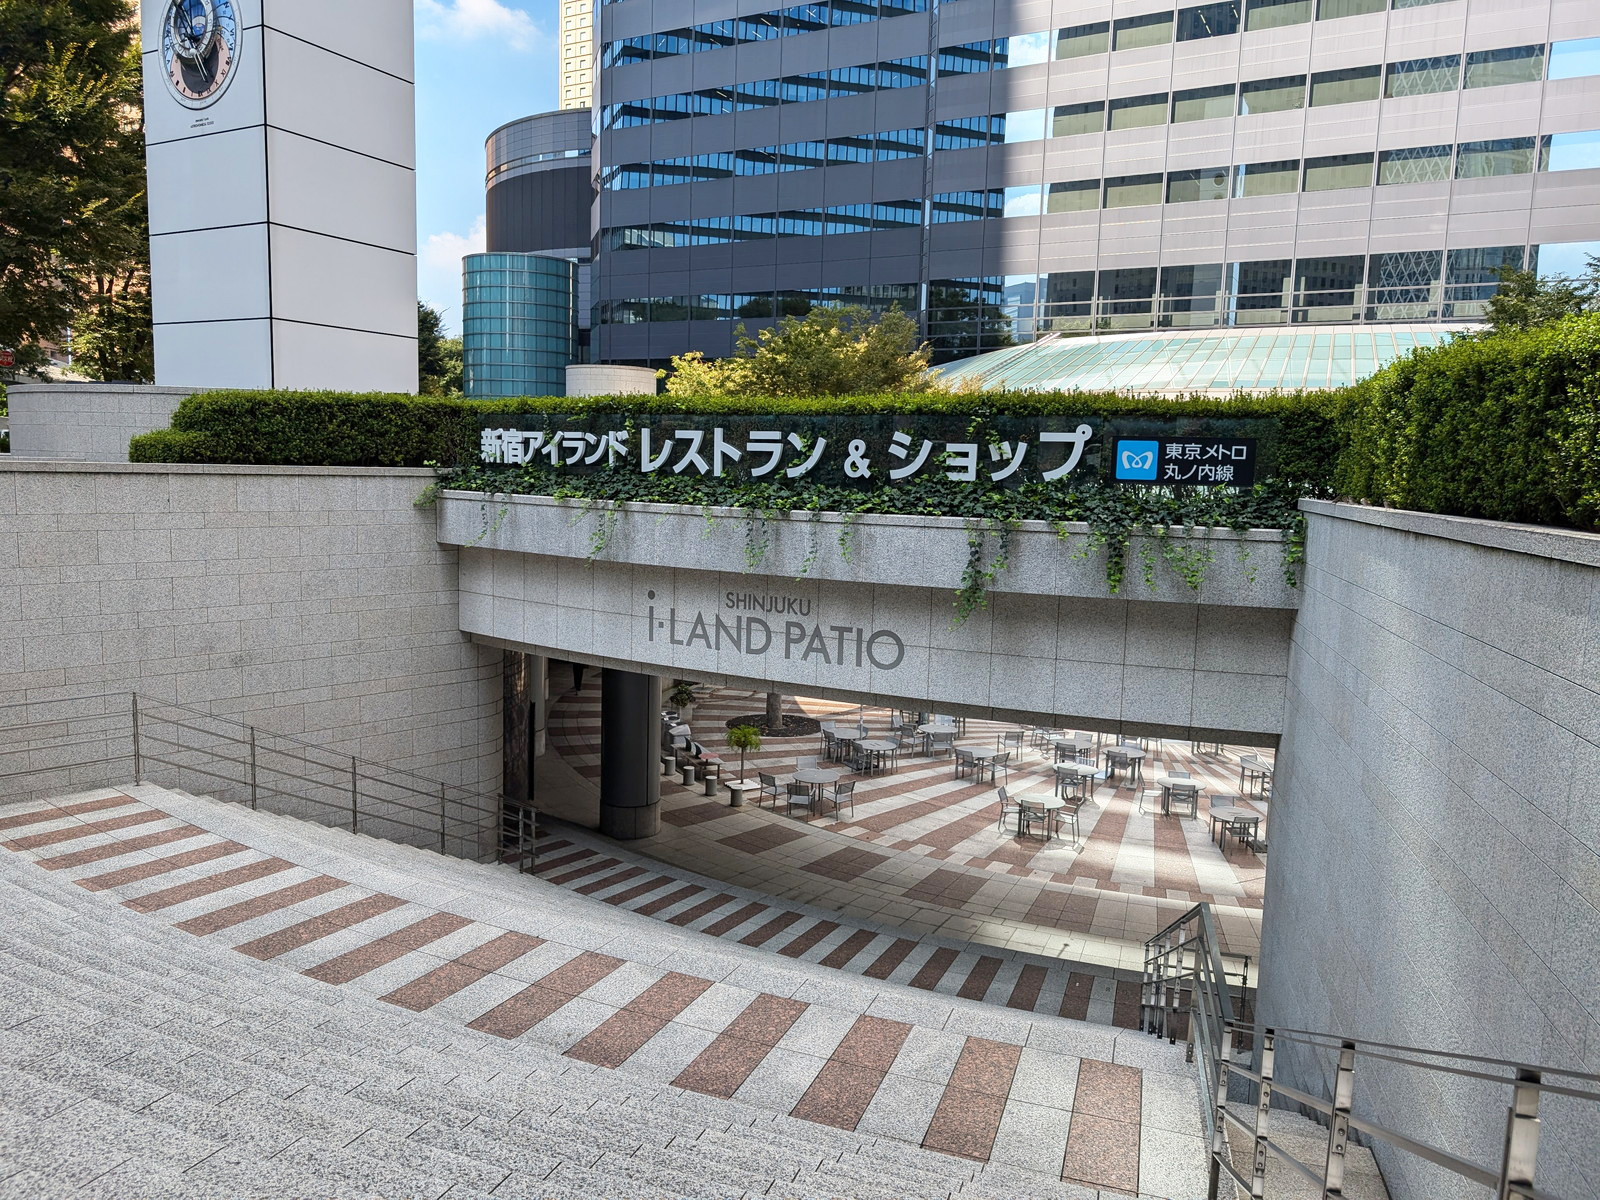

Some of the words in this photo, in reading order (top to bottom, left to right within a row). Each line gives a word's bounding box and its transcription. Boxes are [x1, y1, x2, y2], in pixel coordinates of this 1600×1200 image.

[480, 427, 630, 467] 新宿アイランド
[641, 427, 827, 479] レストラン
[843, 439, 871, 479] &
[888, 424, 1093, 482] ショップ
[1165, 443, 1247, 461] 東京メトロ
[1163, 463, 1235, 482] 丸ノ内線
[725, 591, 812, 617] SHINJUKU
[784, 620, 905, 671] PATIO
